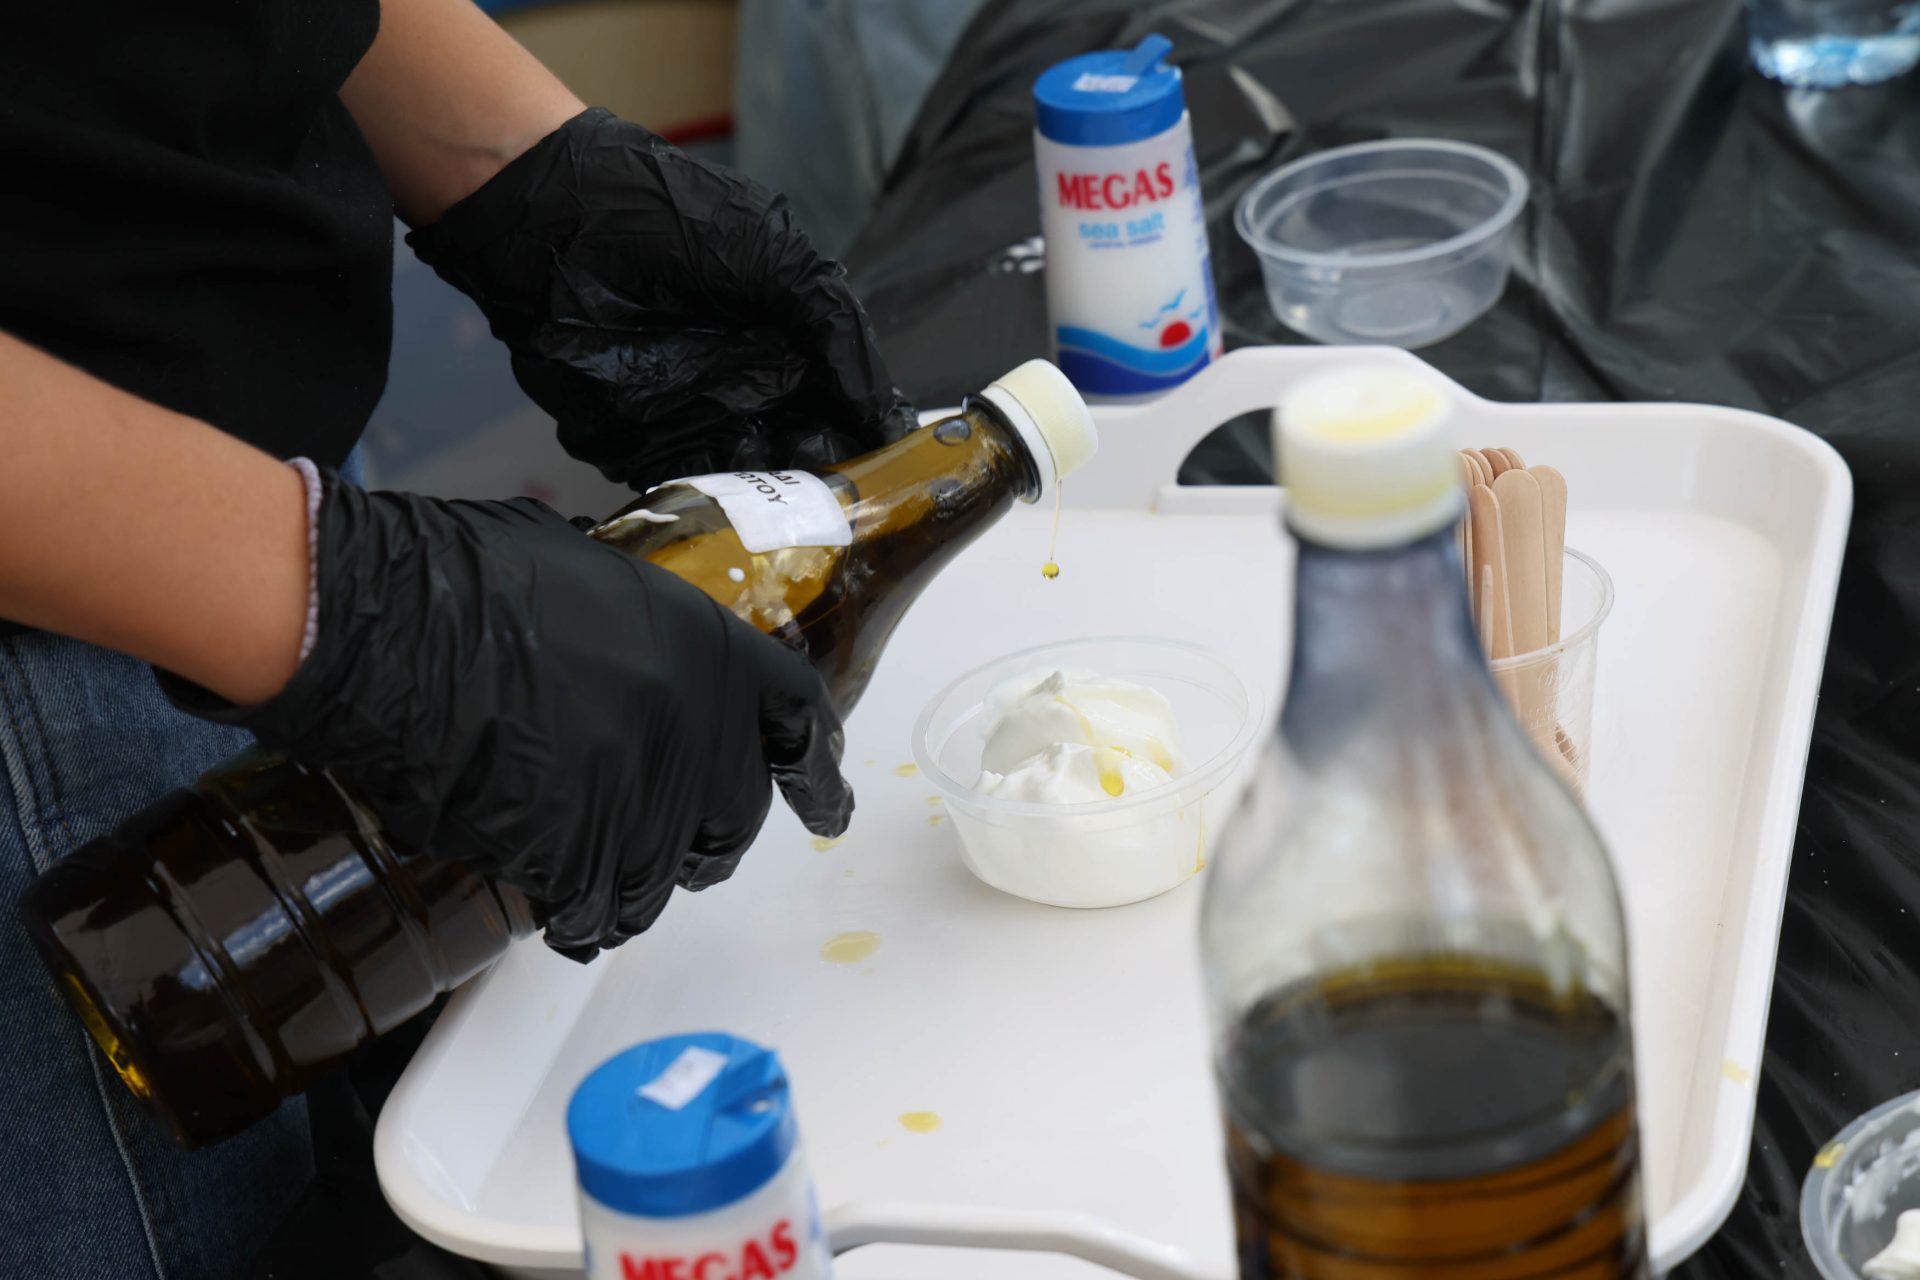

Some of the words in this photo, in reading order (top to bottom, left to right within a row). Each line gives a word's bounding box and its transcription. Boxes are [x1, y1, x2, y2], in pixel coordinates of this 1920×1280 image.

[1057, 161, 1175, 211] MEGAS
[1078, 223, 1119, 240] sea
[1127, 212, 1165, 237] salt
